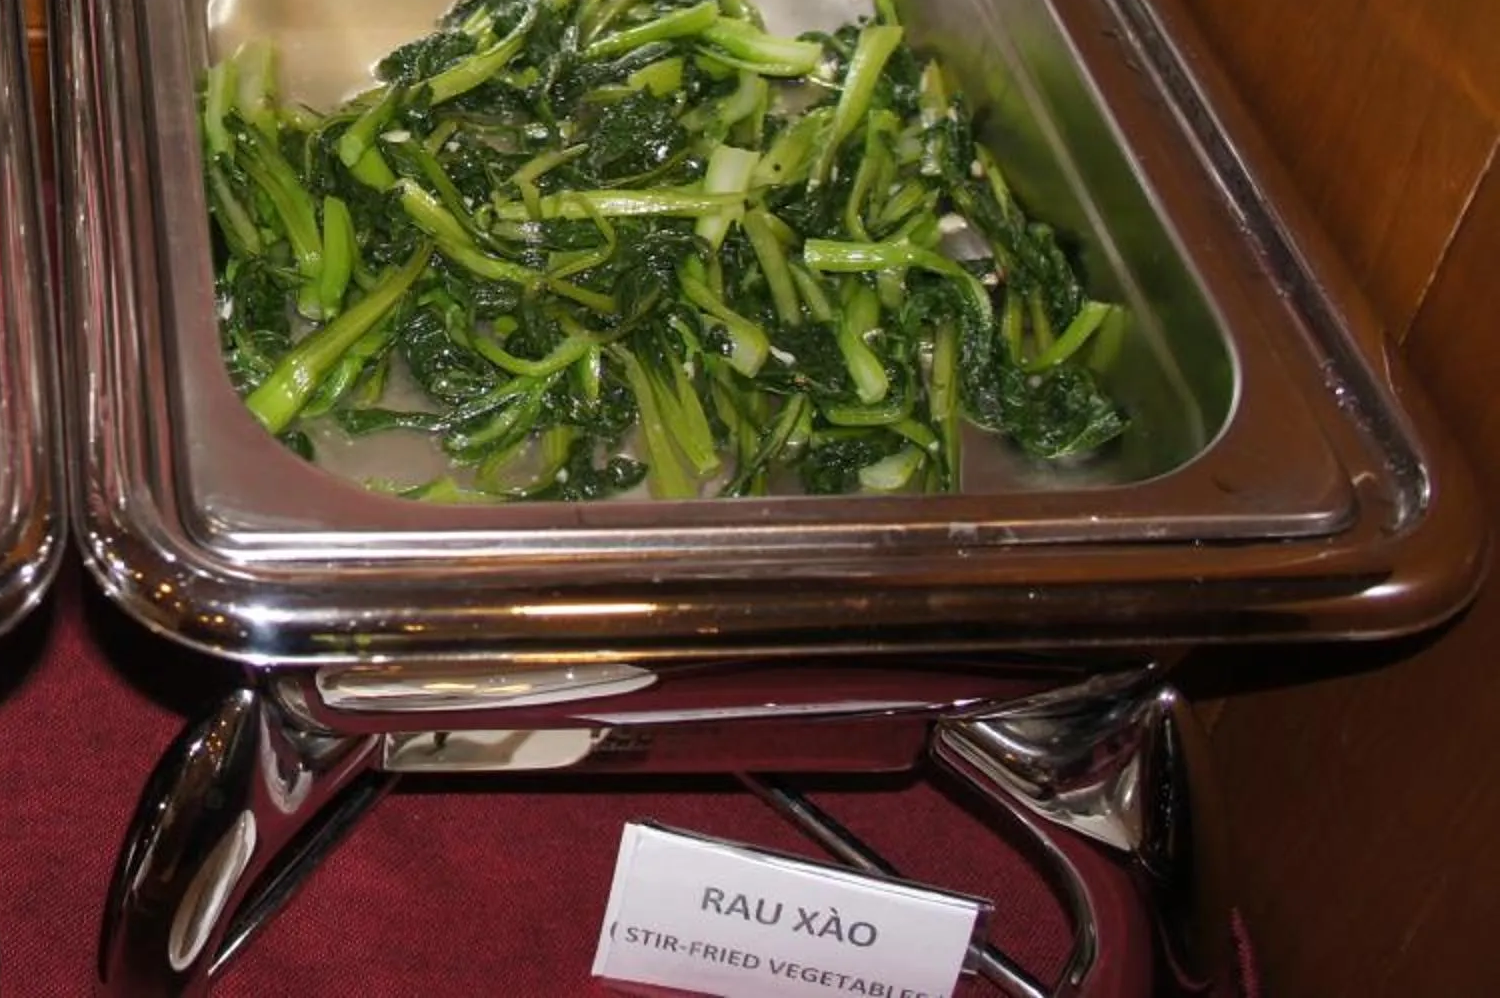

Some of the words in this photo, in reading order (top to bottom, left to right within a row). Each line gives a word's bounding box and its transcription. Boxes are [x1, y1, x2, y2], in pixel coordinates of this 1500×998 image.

[701, 886, 784, 926] RAU
[791, 906, 878, 948] XÀO
[624, 926, 761, 970] STIR-FRIED
[769, 957, 929, 998] VEGETABLE
